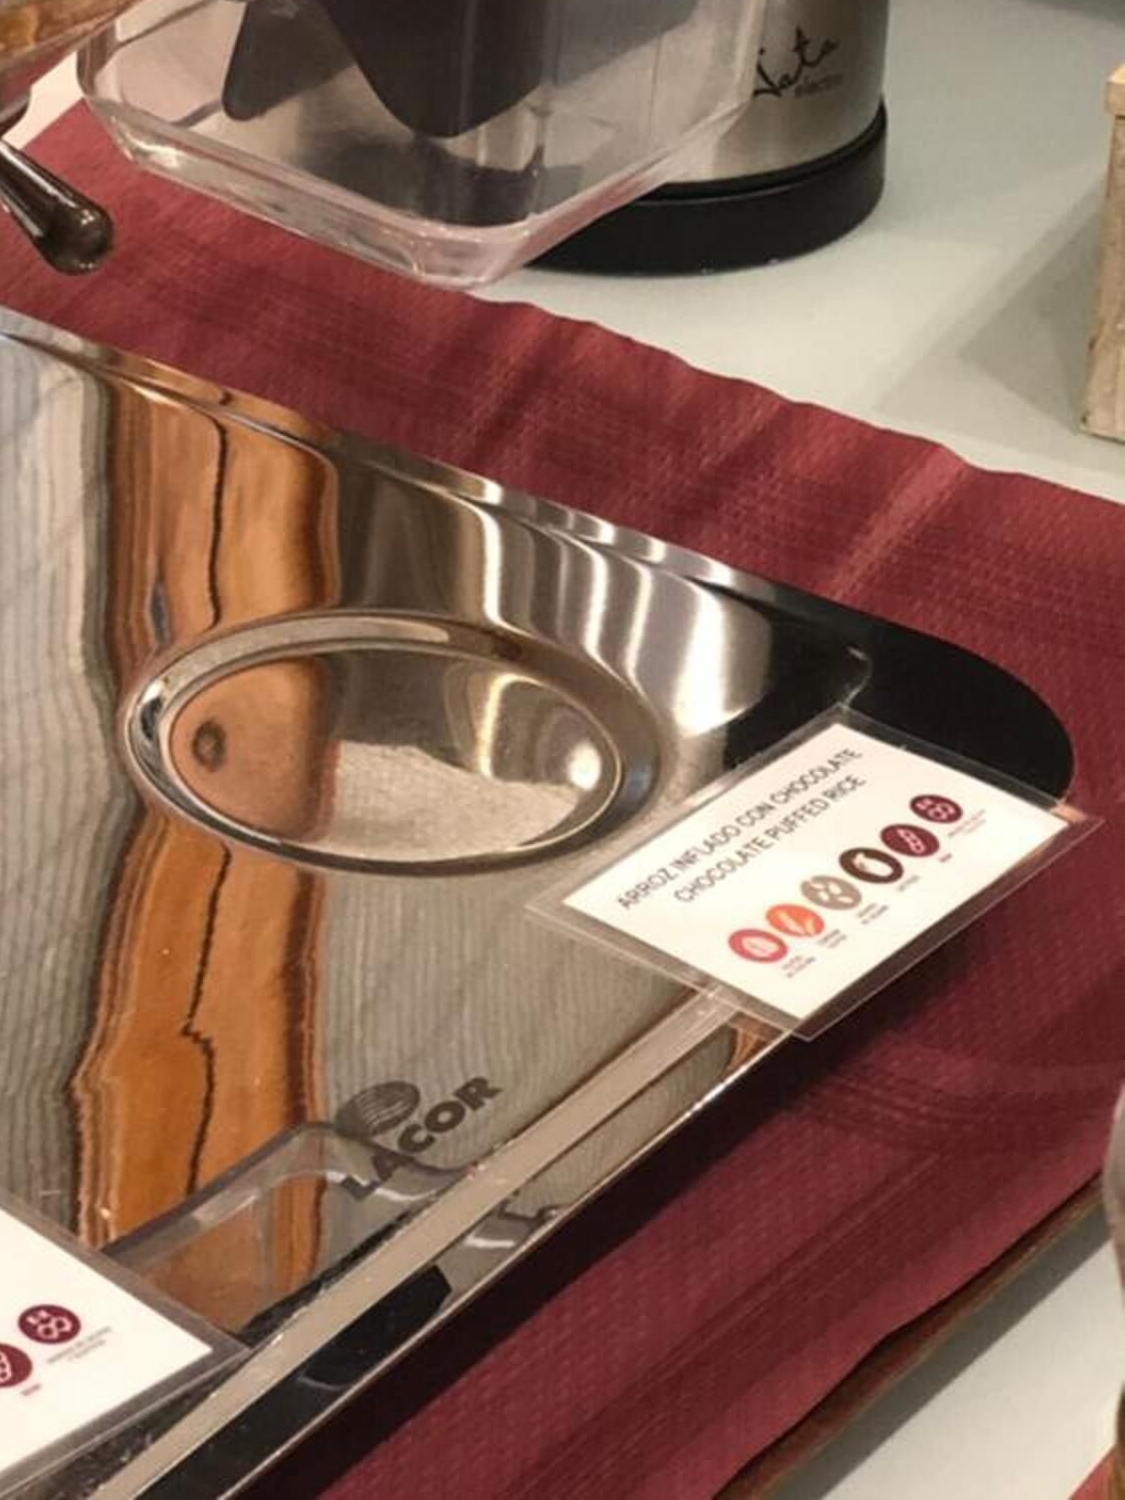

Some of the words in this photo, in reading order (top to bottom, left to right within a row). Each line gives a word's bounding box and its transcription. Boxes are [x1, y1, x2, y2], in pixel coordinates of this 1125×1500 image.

[618, 867, 677, 910] ARROZ
[671, 824, 741, 872] INFLADO
[736, 802, 775, 828] CON
[769, 748, 864, 805] CHOCOLATE
[673, 835, 773, 903] CHOCOLATE
[767, 798, 829, 842] PUFFED
[823, 773, 867, 802] RICE
[340, 1076, 503, 1200] LACOR
